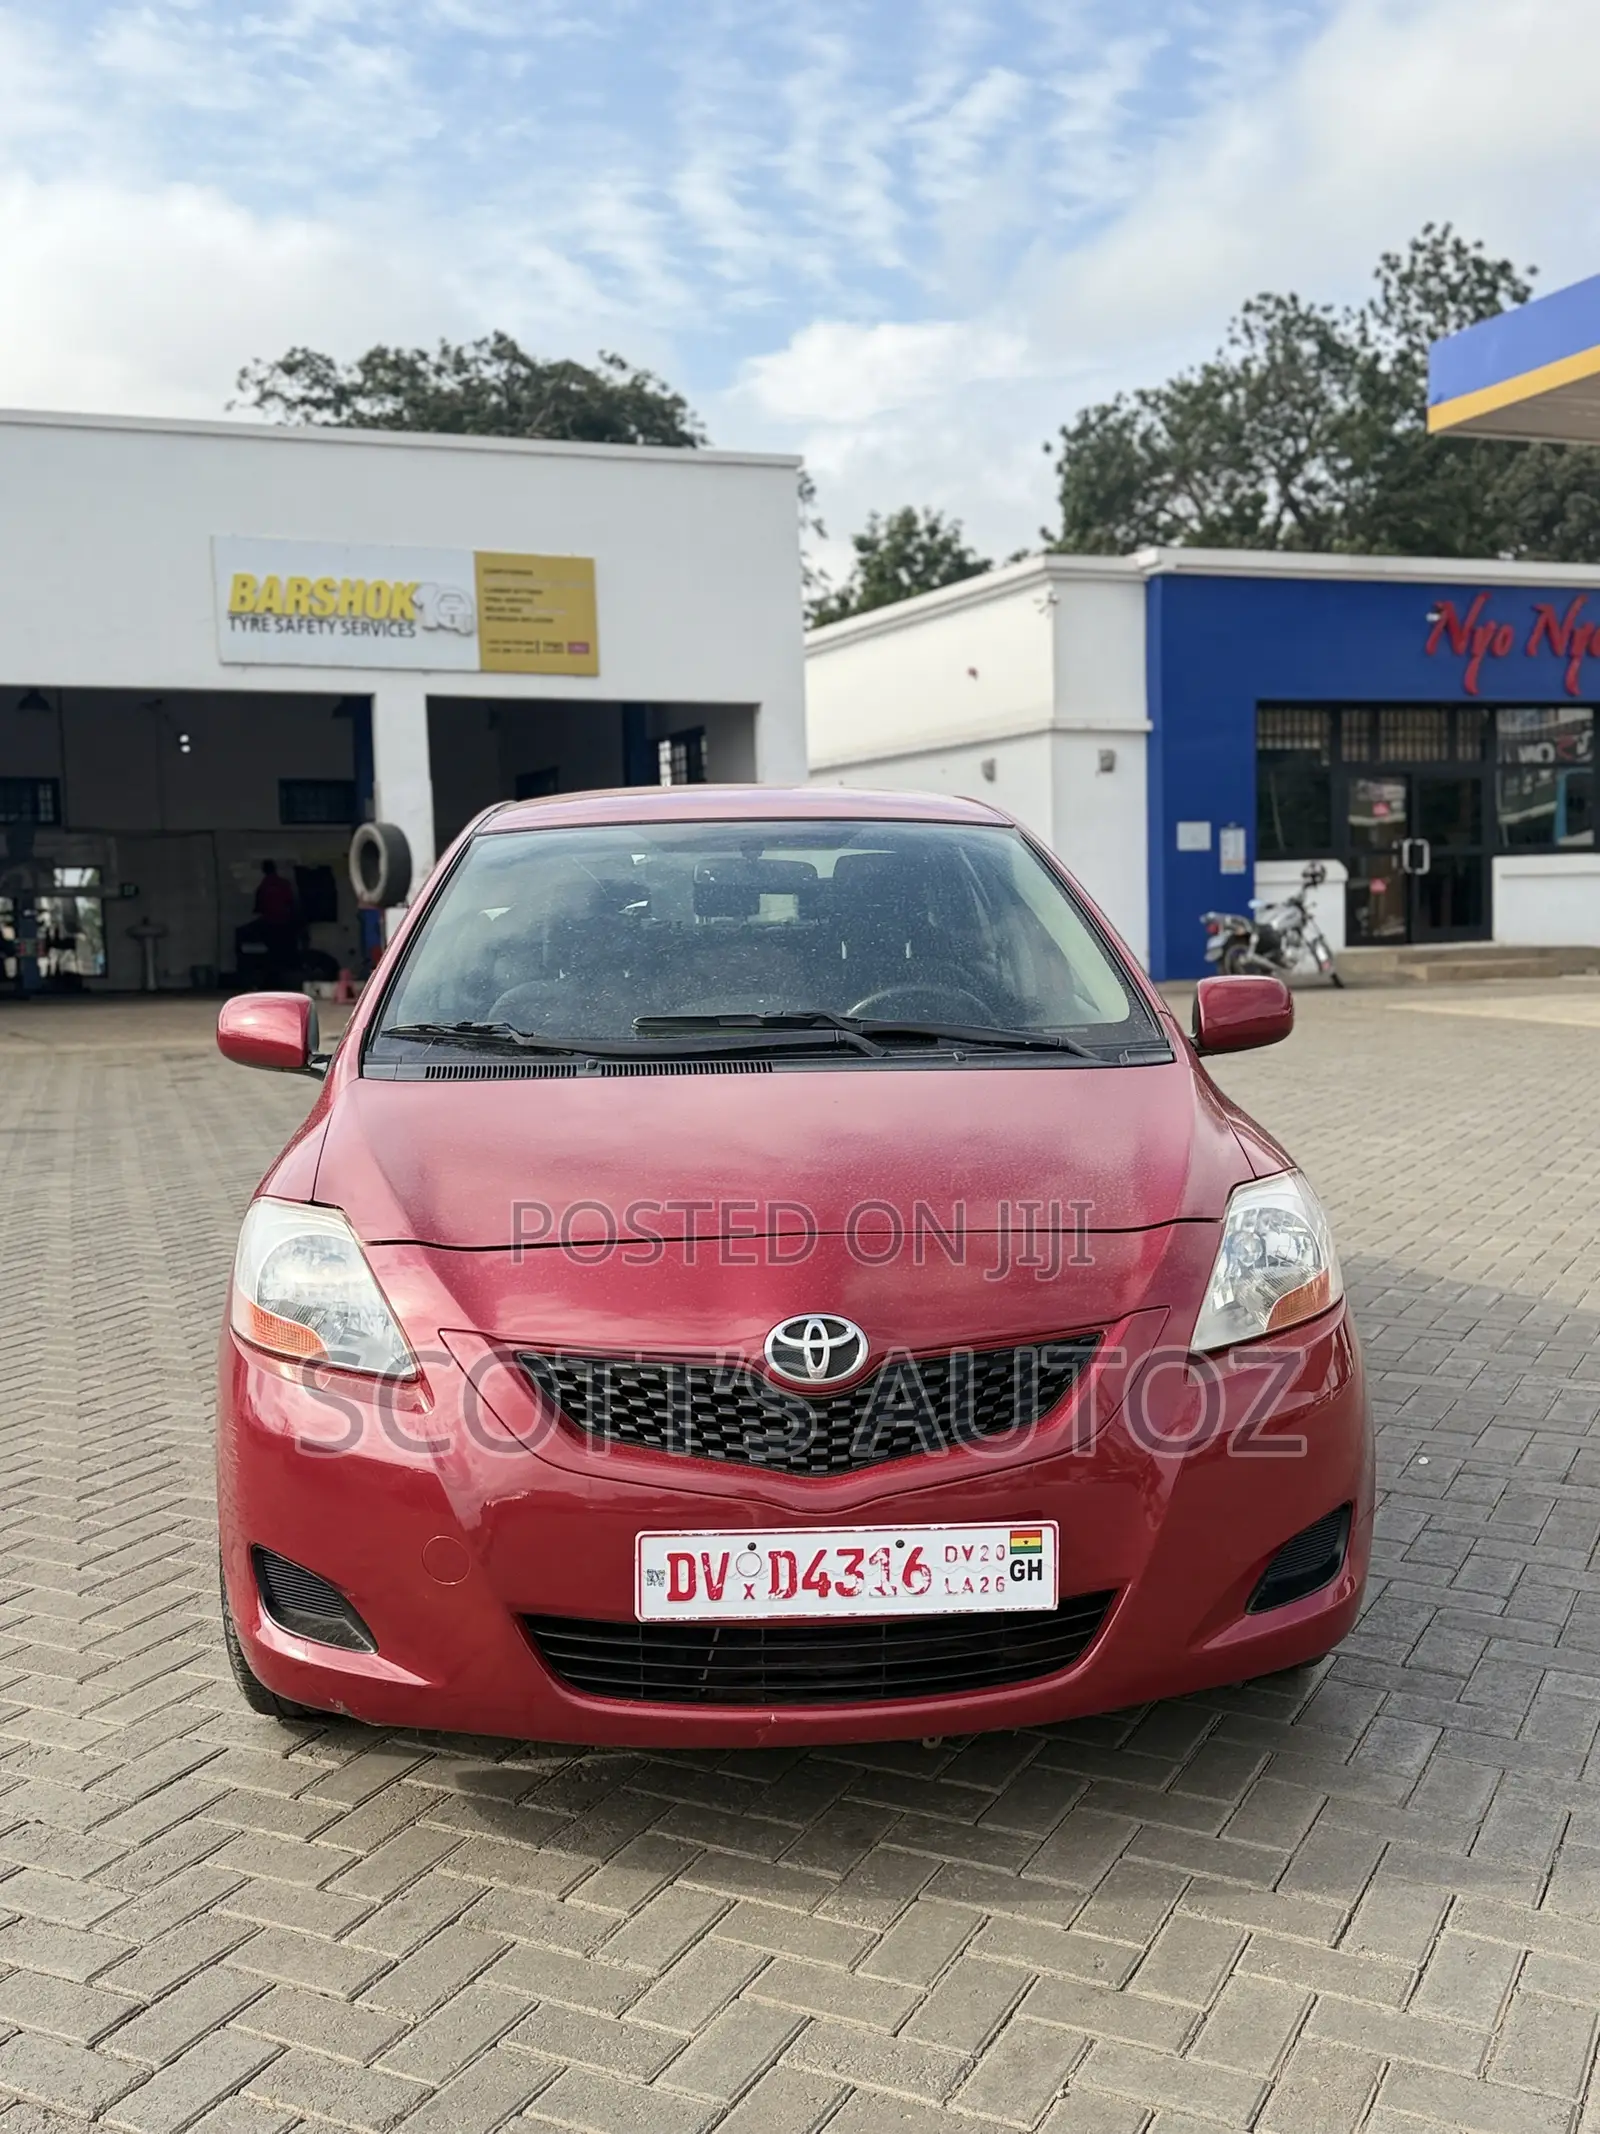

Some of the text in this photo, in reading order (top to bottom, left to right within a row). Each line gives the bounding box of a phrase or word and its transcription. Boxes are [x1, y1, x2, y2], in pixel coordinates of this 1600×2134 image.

[228, 573, 420, 622] BARSHOK
[228, 615, 416, 638] TYRE SAFETY SERVICES
[1425, 590, 1515, 696] Nyo
[666, 1545, 933, 1602] DV D4316
[1009, 1558, 1043, 1582] GH
